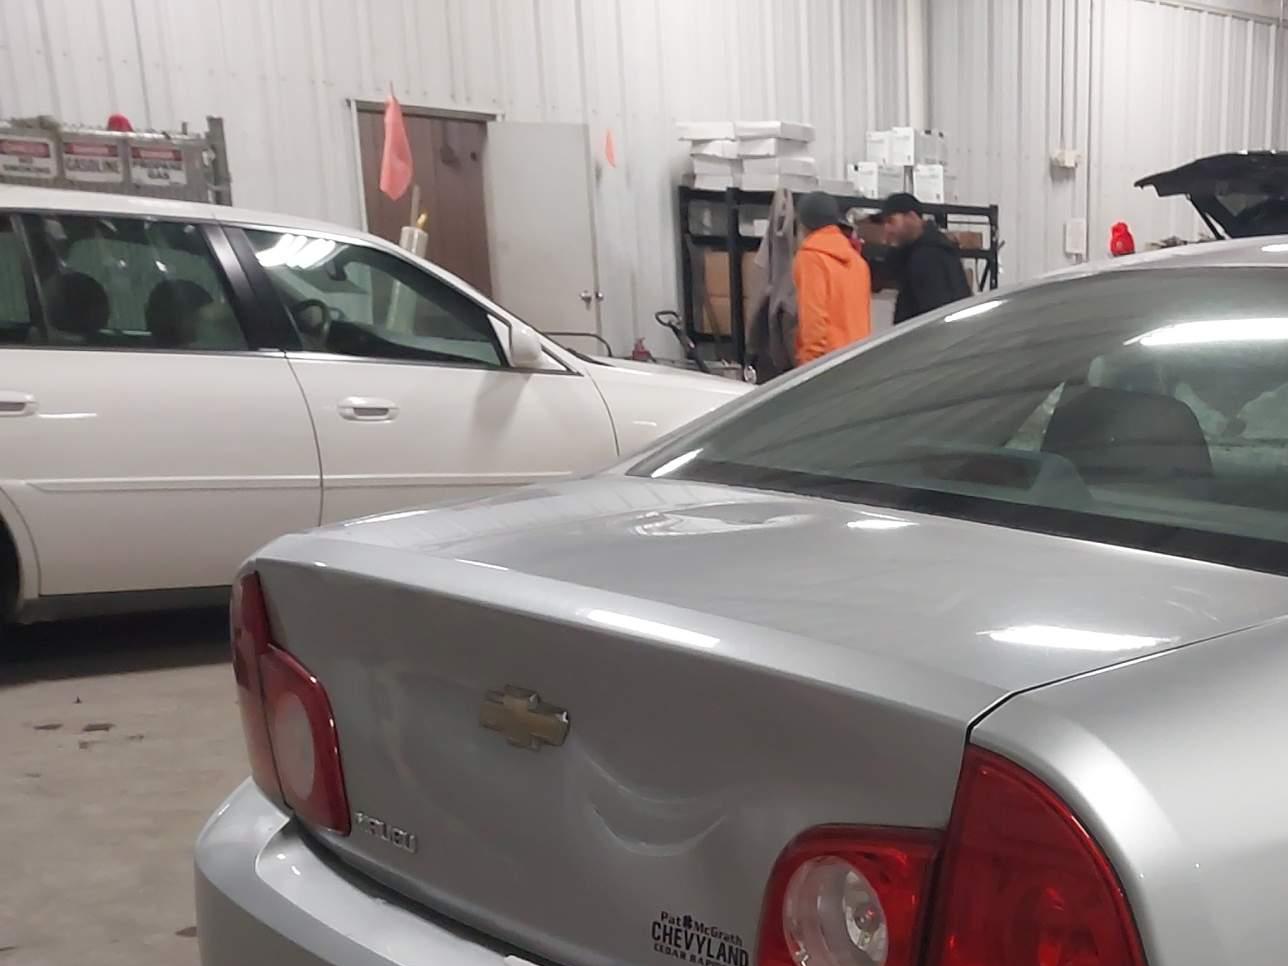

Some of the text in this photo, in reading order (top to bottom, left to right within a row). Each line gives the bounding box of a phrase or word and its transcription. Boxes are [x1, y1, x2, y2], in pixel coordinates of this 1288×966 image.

[661, 911, 743, 946] Pat McGrath
[654, 943, 686, 960] CEDAR
